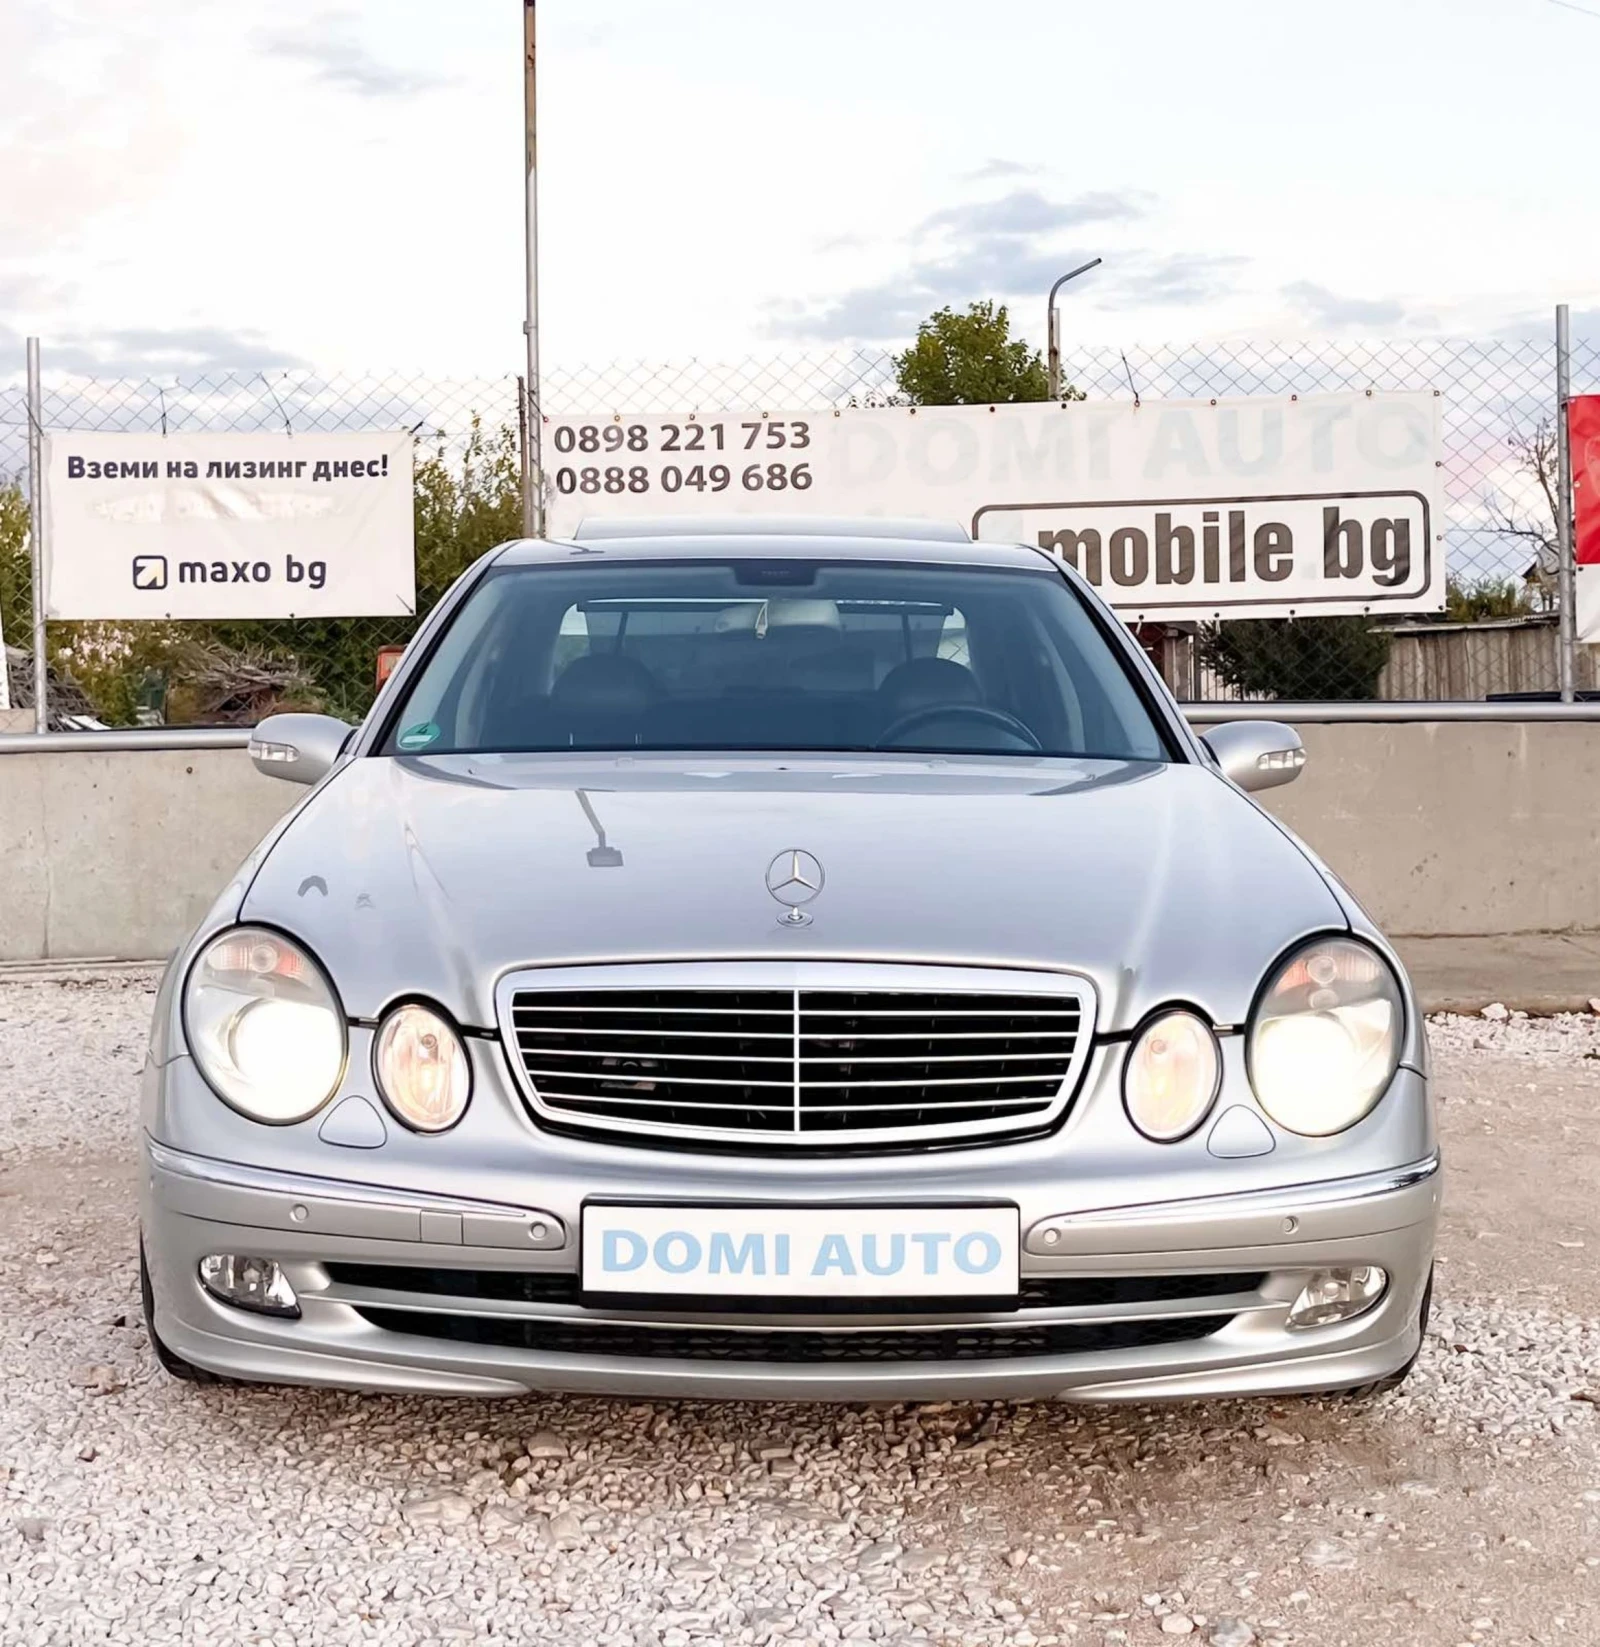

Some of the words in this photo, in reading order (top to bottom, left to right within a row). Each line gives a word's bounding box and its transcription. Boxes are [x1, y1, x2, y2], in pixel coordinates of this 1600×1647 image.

[553, 425, 649, 454] 0898
[660, 423, 725, 452] 221
[741, 421, 811, 450] 753
[836, 412, 1112, 487] DOMI
[1141, 402, 1430, 480] AUTO
[67, 455, 159, 480] Вземи
[166, 461, 199, 479] на
[205, 461, 308, 479] лизинг
[312, 453, 388, 482] днес!
[555, 465, 650, 495] 0888
[660, 464, 731, 493] 049
[741, 462, 813, 492] 686
[178, 561, 272, 584] maxo
[286, 553, 327, 590] bg
[601, 1229, 791, 1276] DOMI
[810, 1231, 1002, 1277] AUTO
